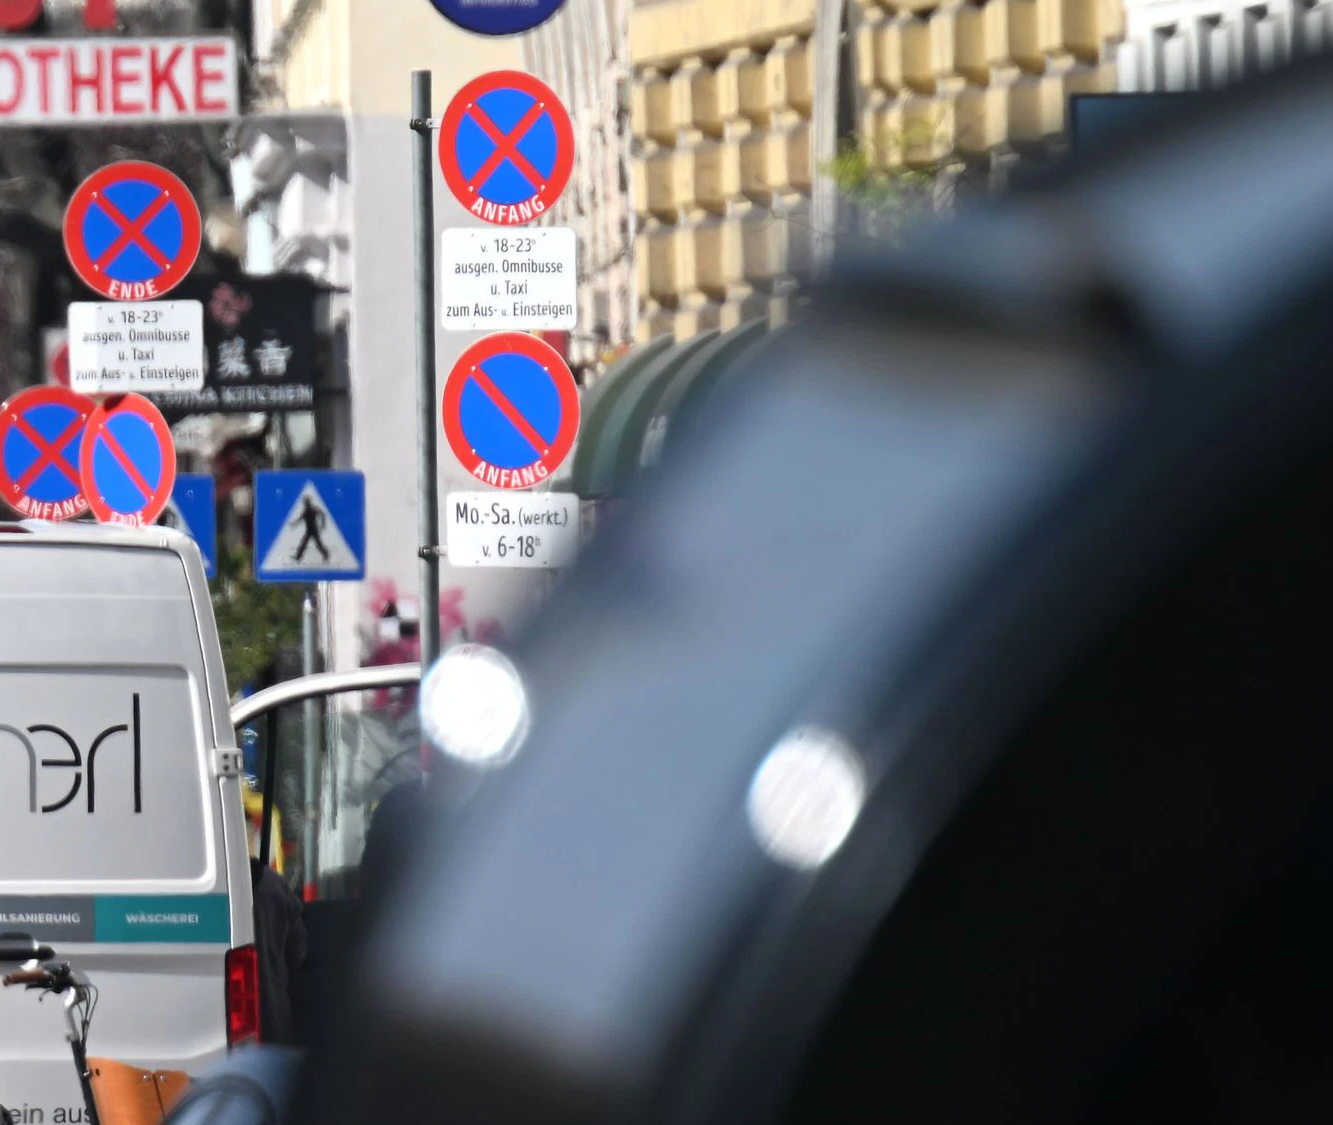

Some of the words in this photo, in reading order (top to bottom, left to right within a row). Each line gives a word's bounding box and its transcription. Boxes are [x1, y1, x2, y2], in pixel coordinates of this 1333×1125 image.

[471, 194, 545, 223] ANFANG
[454, 261, 499, 278] ausgen.
[501, 258, 563, 274] Omnibusse
[108, 278, 159, 300] ENDE
[490, 285, 501, 295] u.
[504, 279, 528, 295] Taxi
[446, 305, 470, 317] zum
[473, 302, 498, 317] Aus-
[512, 301, 573, 319] Einsteigen
[82, 331, 126, 344] ausgen.
[128, 329, 190, 342] Omnibusse
[118, 350, 128, 361] u.
[132, 347, 155, 361] Taxi
[75, 370, 98, 380] zum
[101, 366, 126, 379] Aus-
[140, 366, 199, 382] Einsteigen
[473, 460, 548, 488] ANFANG
[17, 493, 87, 519] ANFANG
[455, 502, 516, 526] Mo.-Sa.
[518, 507, 568, 527] (werkt.)
[124, 911, 200, 924] WÄSCHEREI
